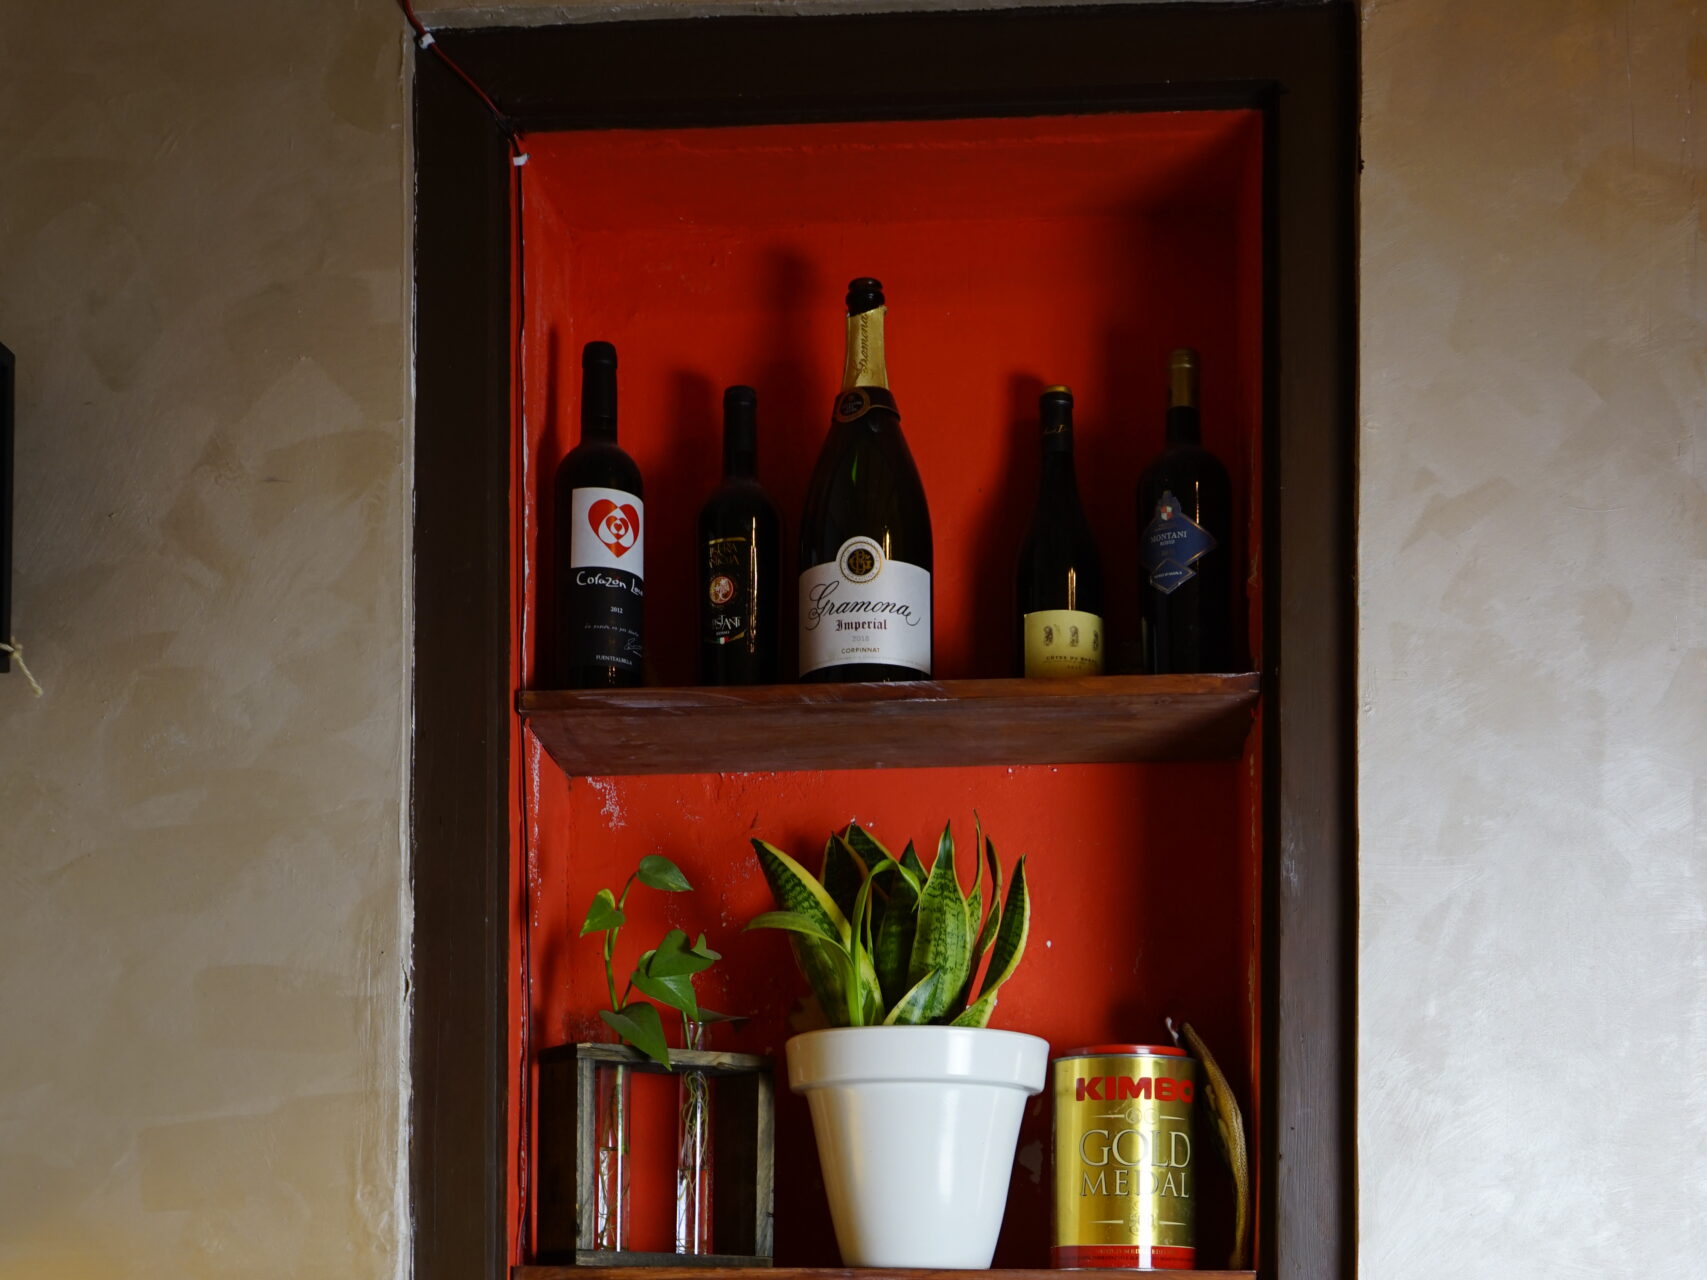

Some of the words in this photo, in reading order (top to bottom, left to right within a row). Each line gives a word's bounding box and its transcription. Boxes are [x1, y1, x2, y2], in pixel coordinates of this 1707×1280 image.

[804, 580, 922, 632] Gramona
[835, 619, 888, 632] Imperial
[1075, 1076, 1194, 1103] KIMBO
[1079, 1129, 1191, 1168] GOLD
[1080, 1169, 1190, 1198] MEDAL
